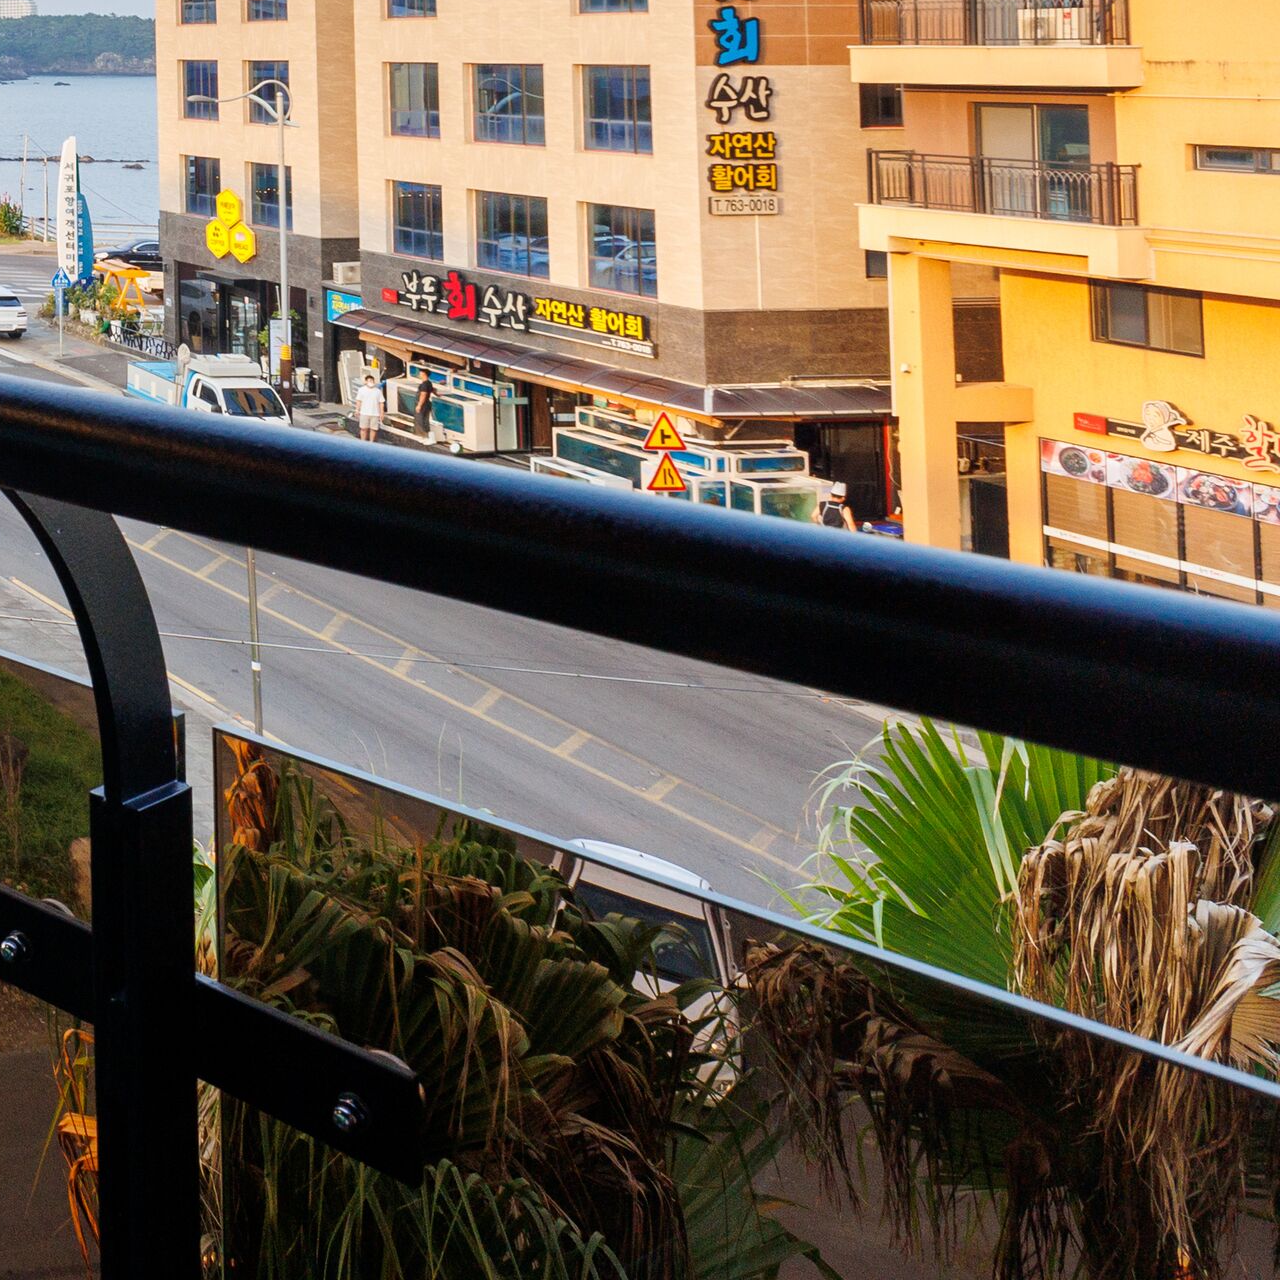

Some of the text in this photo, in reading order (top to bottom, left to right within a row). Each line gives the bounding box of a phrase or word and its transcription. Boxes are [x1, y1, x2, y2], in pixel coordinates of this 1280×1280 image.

[710, 7, 759, 65] 회
[709, 75, 772, 123] 수산
[710, 132, 776, 159] 자연산
[711, 165, 777, 190] 활어회
[402, 271, 644, 341] 부두 회 수산 자연산 활어회
[1186, 416, 1280, 472] 제주 할
